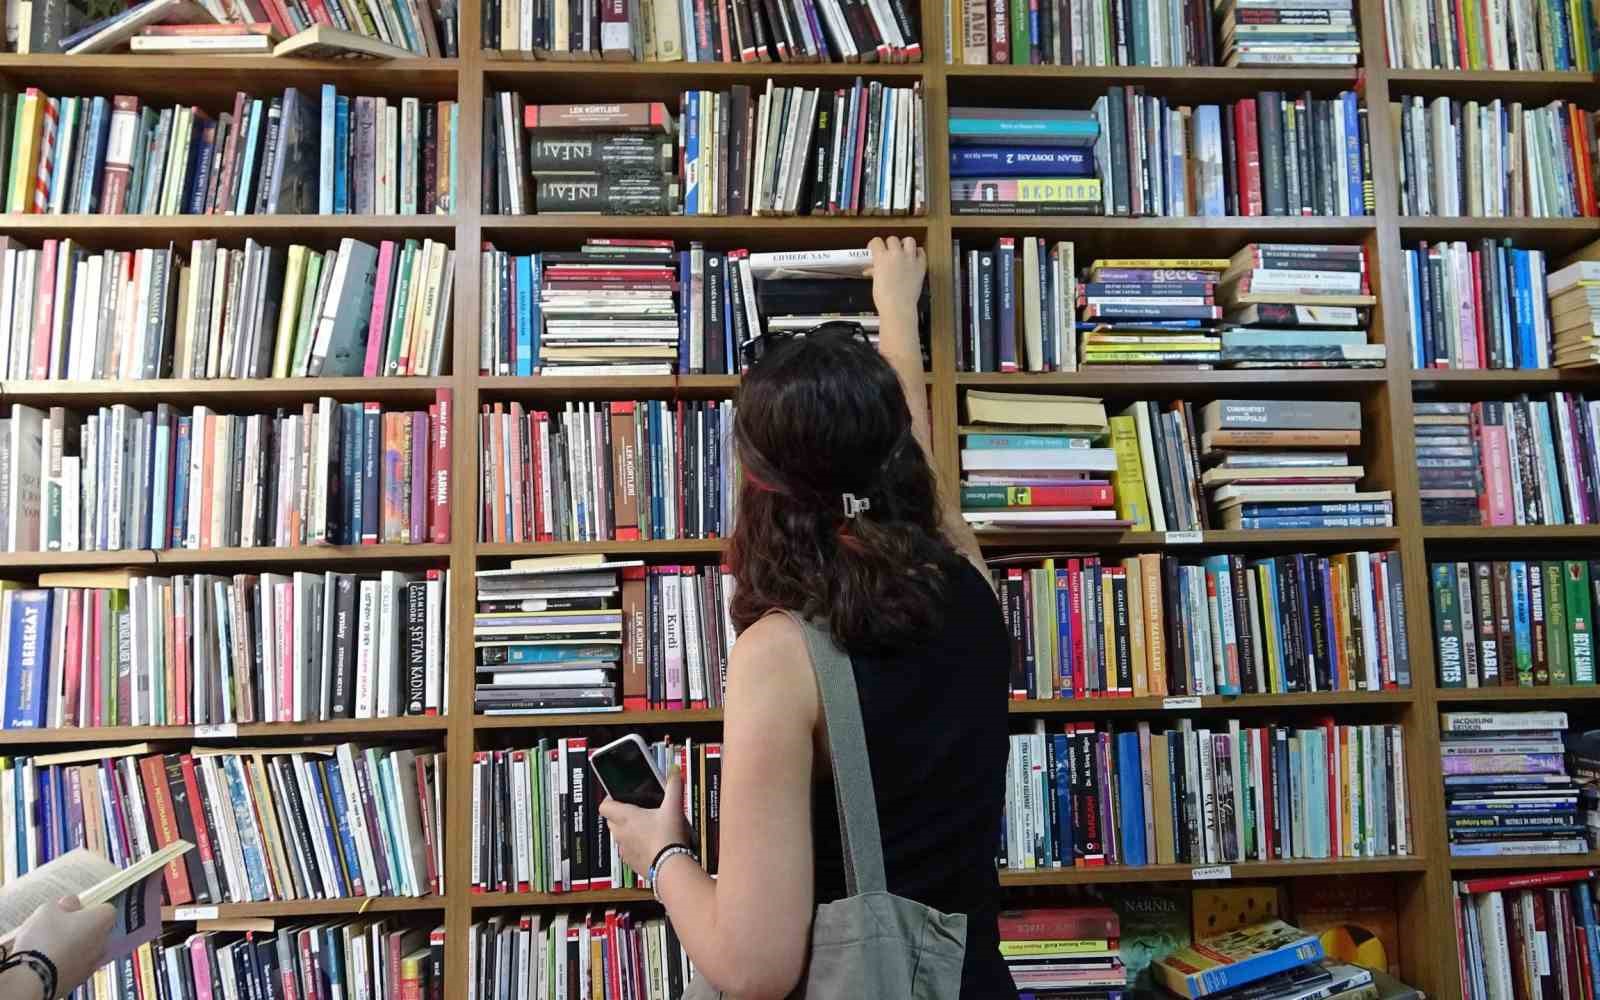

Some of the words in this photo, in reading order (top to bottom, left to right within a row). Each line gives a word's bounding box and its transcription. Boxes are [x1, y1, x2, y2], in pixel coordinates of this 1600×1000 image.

[1006, 154, 1014, 164] 2
[1153, 270, 1197, 283] gece
[437, 470, 447, 506] SARMAL
[417, 585, 425, 623] YASMINE
[635, 612, 643, 630] LEK
[408, 626, 424, 663] ŞEYTAN
[1440, 637, 1461, 683] SOKRATES
[1482, 640, 1498, 679] BABIL
[411, 666, 423, 700] KADIN
[573, 768, 584, 802] KÜRTLER
[1125, 899, 1176, 912] NARNIA
